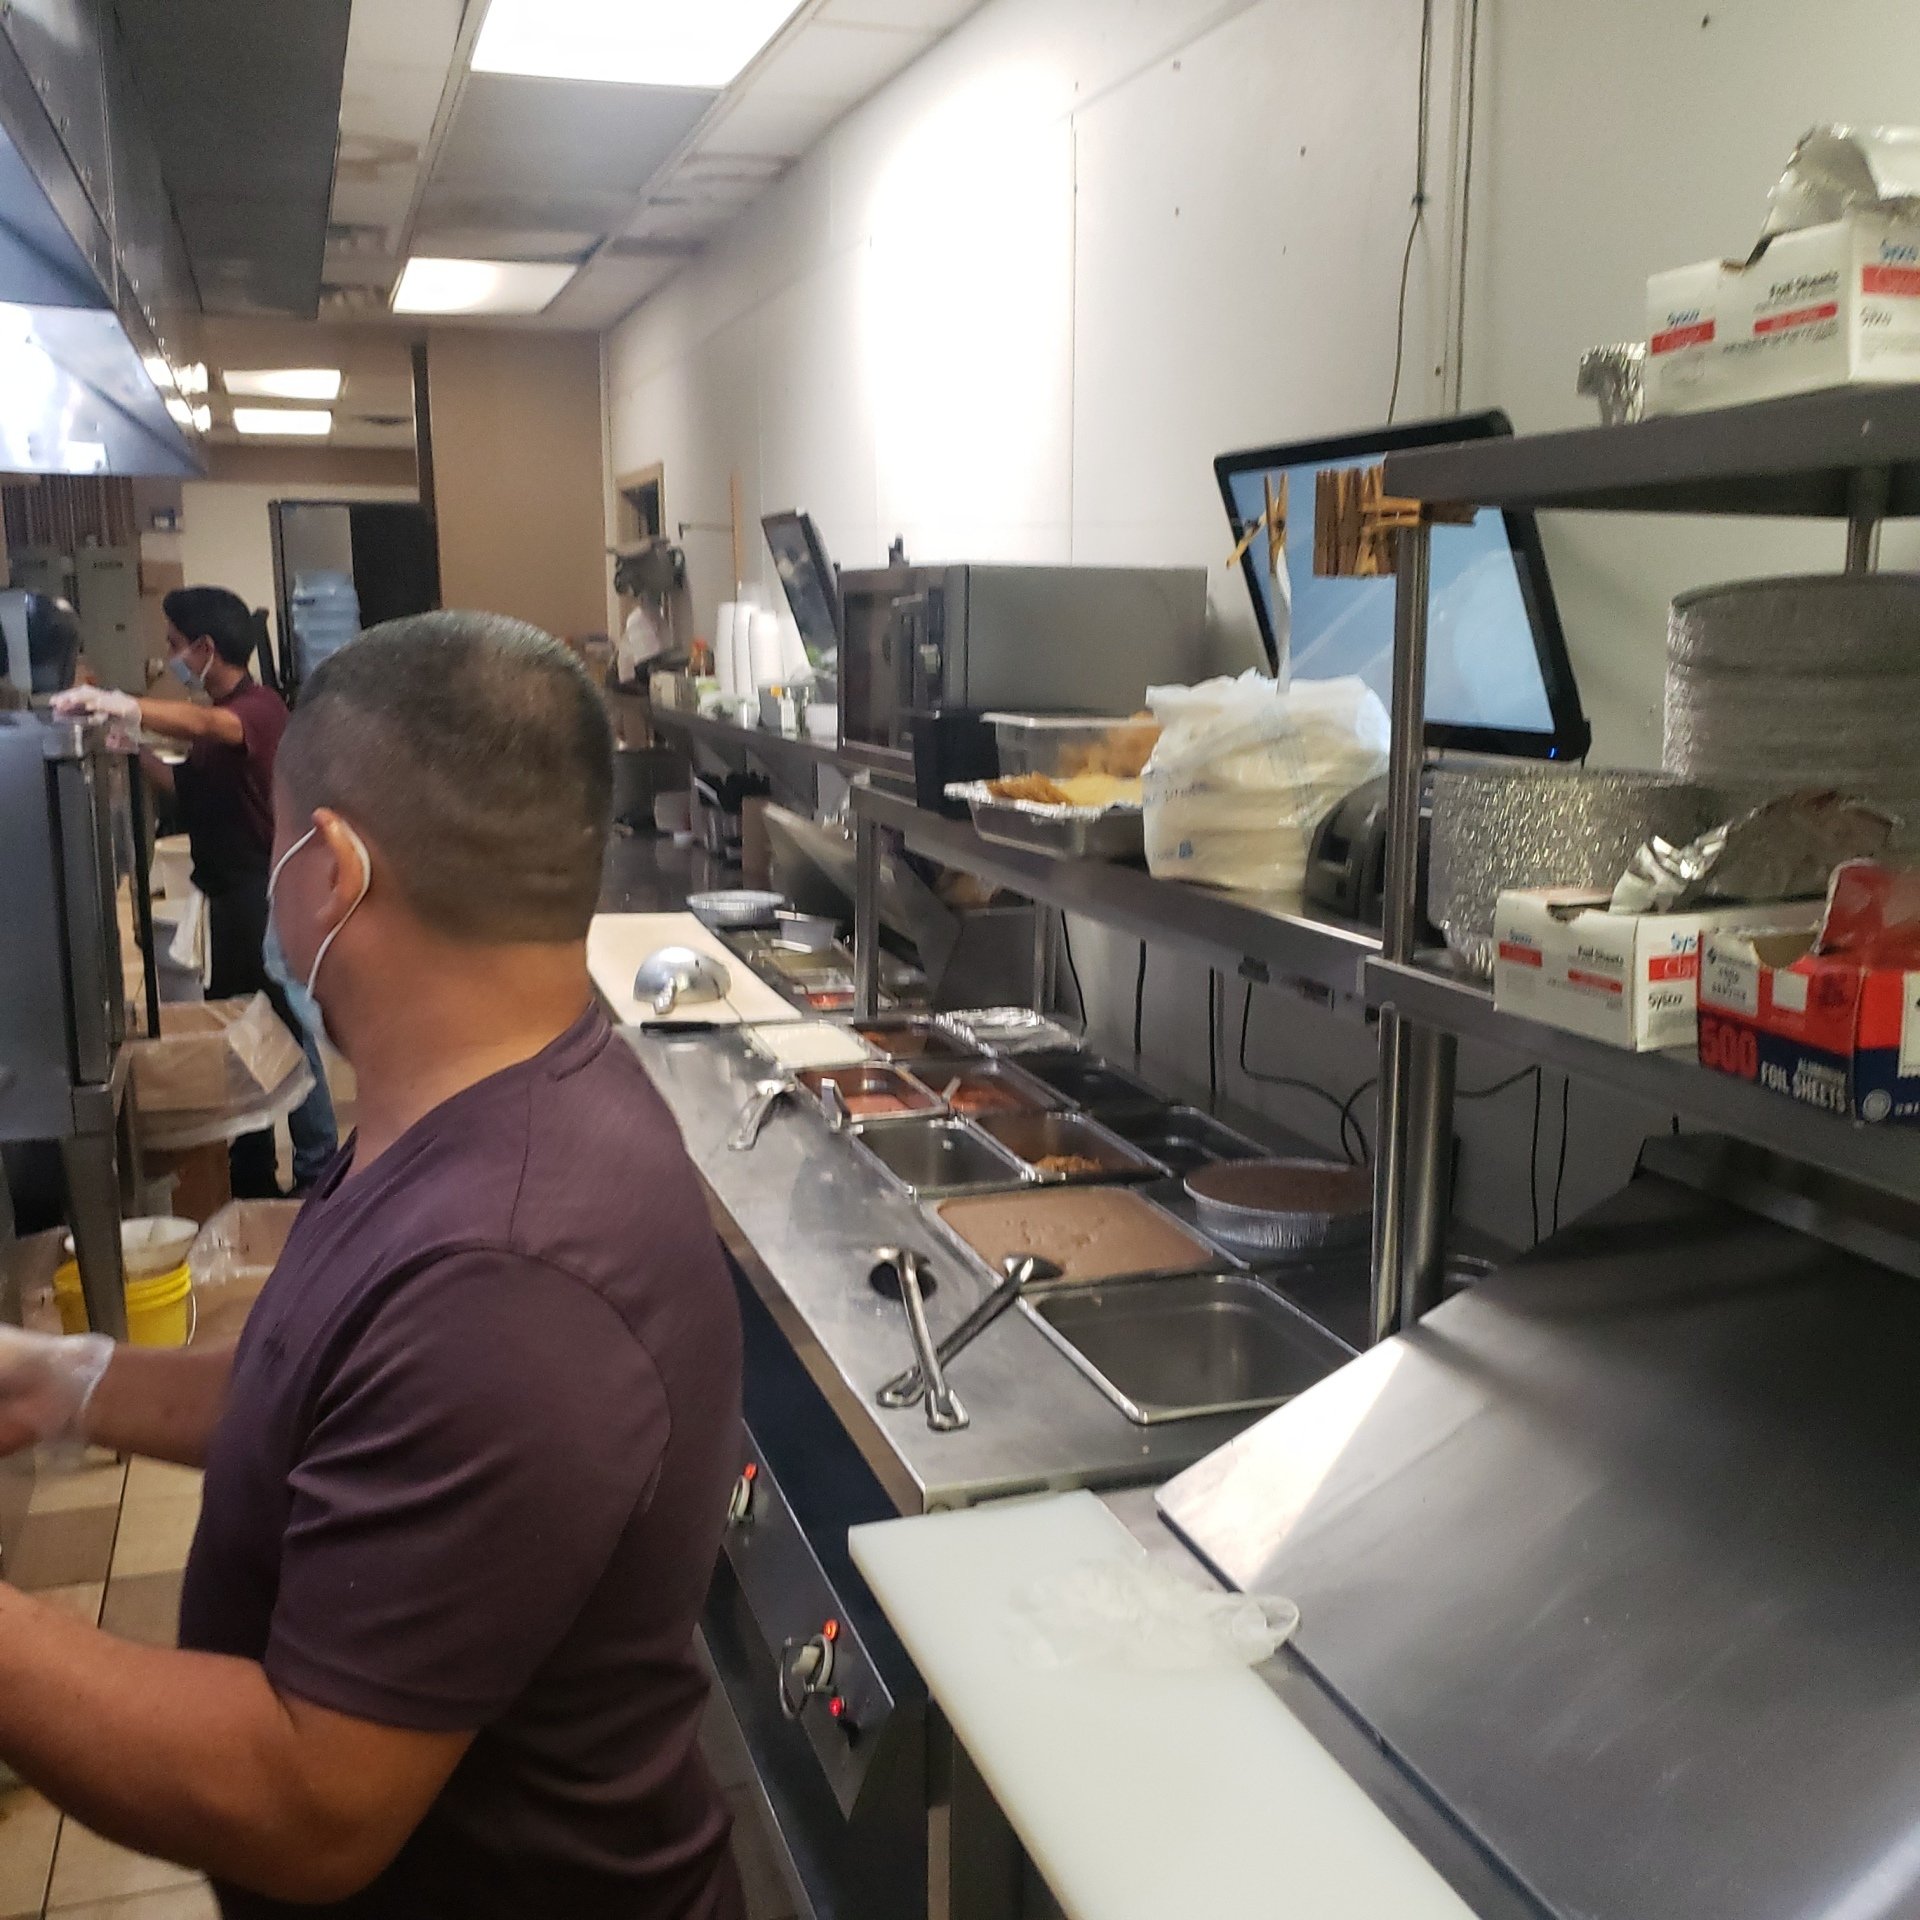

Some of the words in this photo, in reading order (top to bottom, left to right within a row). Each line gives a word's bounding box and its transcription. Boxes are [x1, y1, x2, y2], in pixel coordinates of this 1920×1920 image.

[1647, 992, 1683, 1011] Sysco
[1701, 1016, 1758, 1082] 500
[1761, 1060, 1790, 1096] FOIL
[1792, 1068, 1846, 1114] SHEETS
